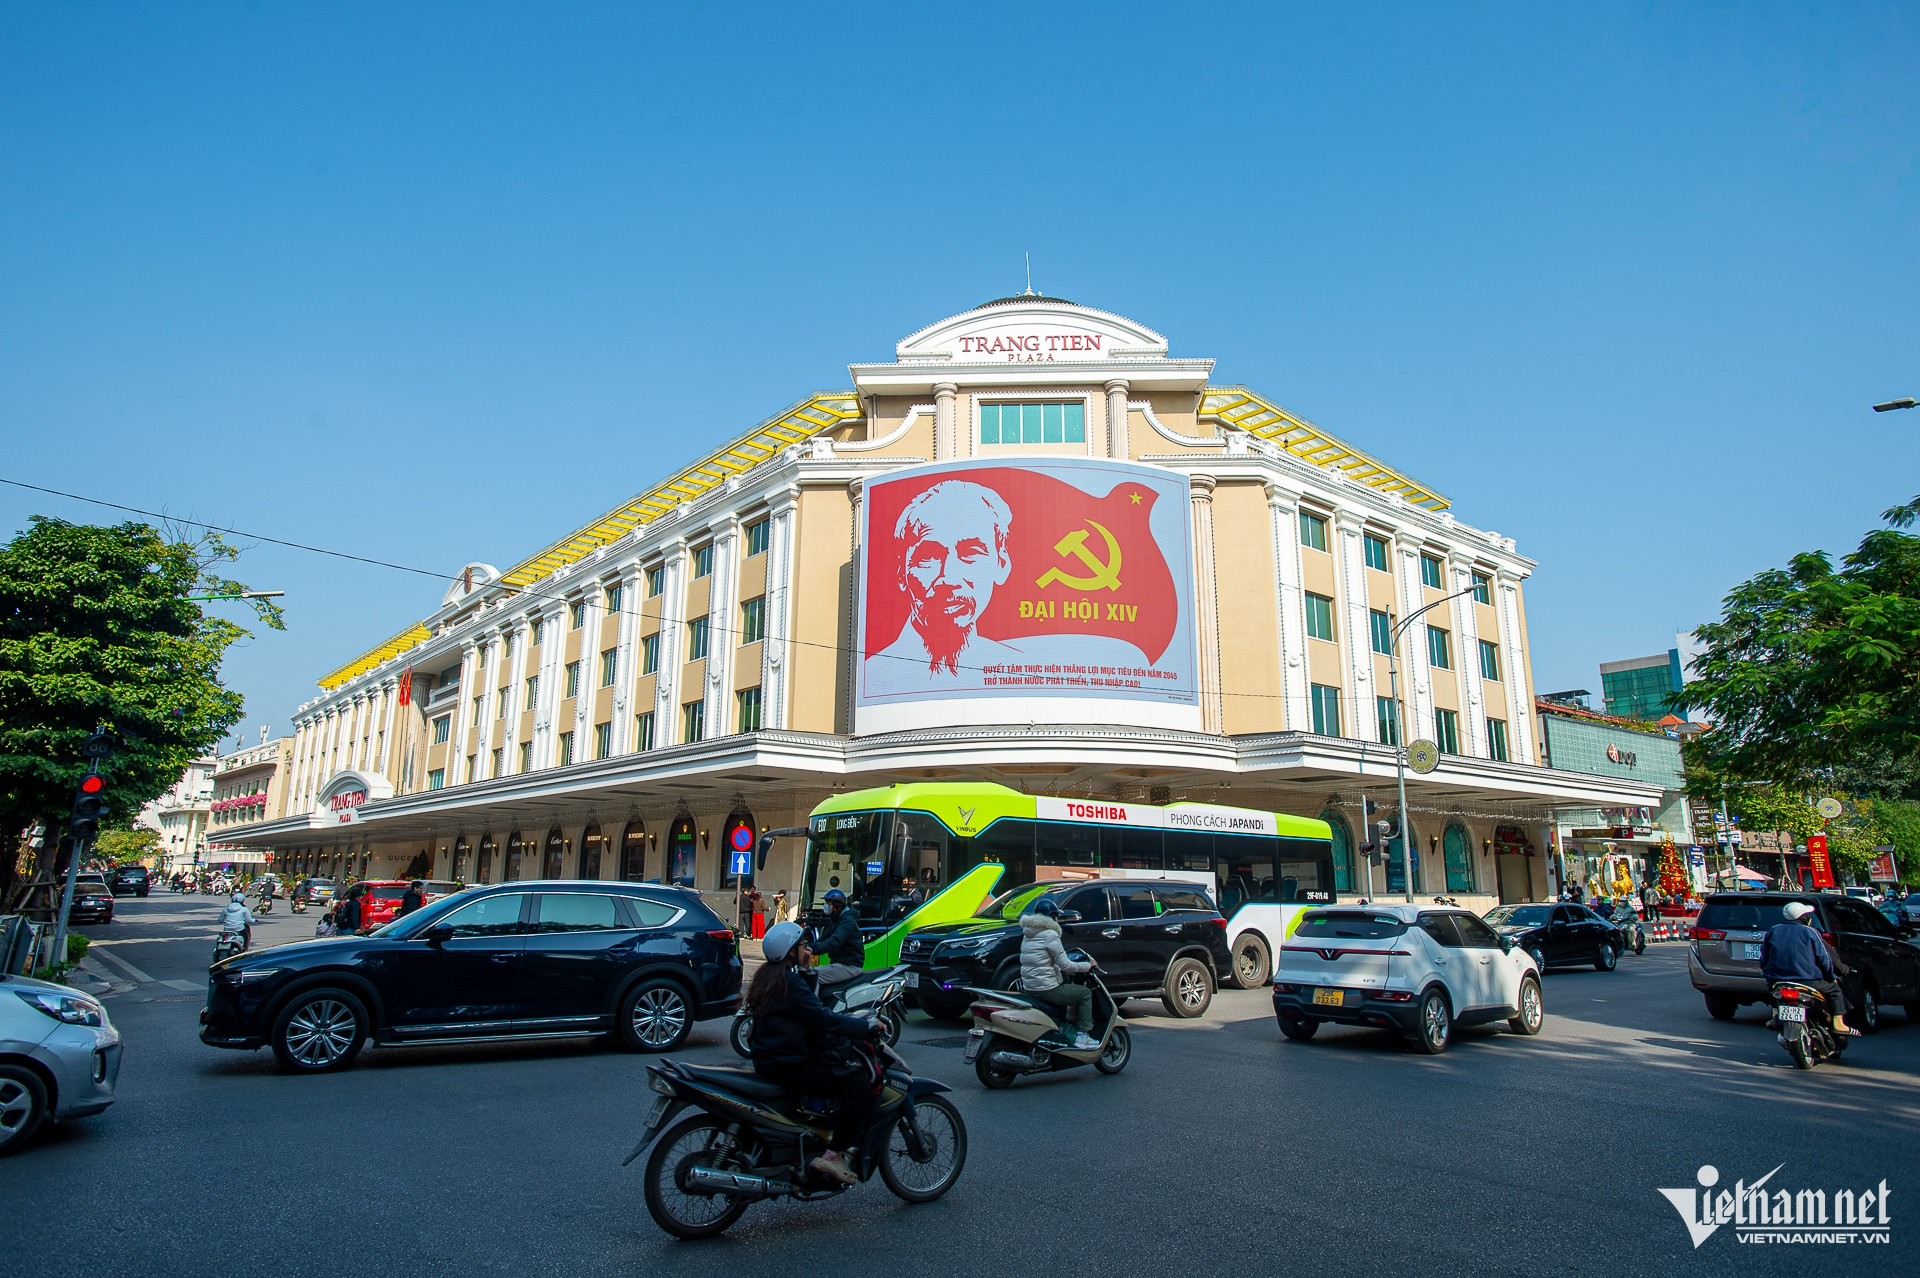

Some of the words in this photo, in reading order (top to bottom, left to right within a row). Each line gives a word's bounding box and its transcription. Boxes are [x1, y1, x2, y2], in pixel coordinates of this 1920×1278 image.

[959, 336, 1040, 354] TRANG
[1045, 335, 1102, 351] TIEN
[1008, 353, 1054, 362] PLAZA
[1019, 601, 1055, 622] ĐẠI
[1063, 597, 1099, 623] HỘI
[1106, 603, 1138, 622] XIV
[983, 662, 1005, 674] QUYẾT
[1007, 664, 1022, 673] TÂM
[1024, 664, 1042, 674] THỰC
[1044, 664, 1061, 674] HIỆN
[1063, 663, 1086, 674] THẮNG
[1087, 665, 1099, 676] LỢI
[1101, 666, 1116, 676] MỤC
[1118, 667, 1132, 676] TIÊU
[1133, 667, 1146, 677] ĐẾN
[1148, 669, 1162, 678] NĂM
[1163, 671, 1178, 680] 2045
[983, 674, 997, 685] TRỞ
[999, 675, 1022, 685] THÀNH
[1024, 675, 1044, 685] NƯỚC
[1046, 675, 1064, 685] PHÁT
[1066, 674, 1088, 686] TRIỂN,
[1090, 677, 1103, 686] THU
[1105, 677, 1123, 688] NHẬP
[1125, 679, 1141, 688] CAO!
[331, 793, 351, 813] TRANG
[351, 789, 366, 808] TIEN
[1067, 803, 1127, 820] TOSHIBA
[956, 825, 977, 833] VINBUS
[1171, 813, 1202, 826] PHONG
[1203, 815, 1227, 828] CÁCH
[1228, 819, 1264, 830] JAPANDi
[1751, 944, 1760, 952] 30
